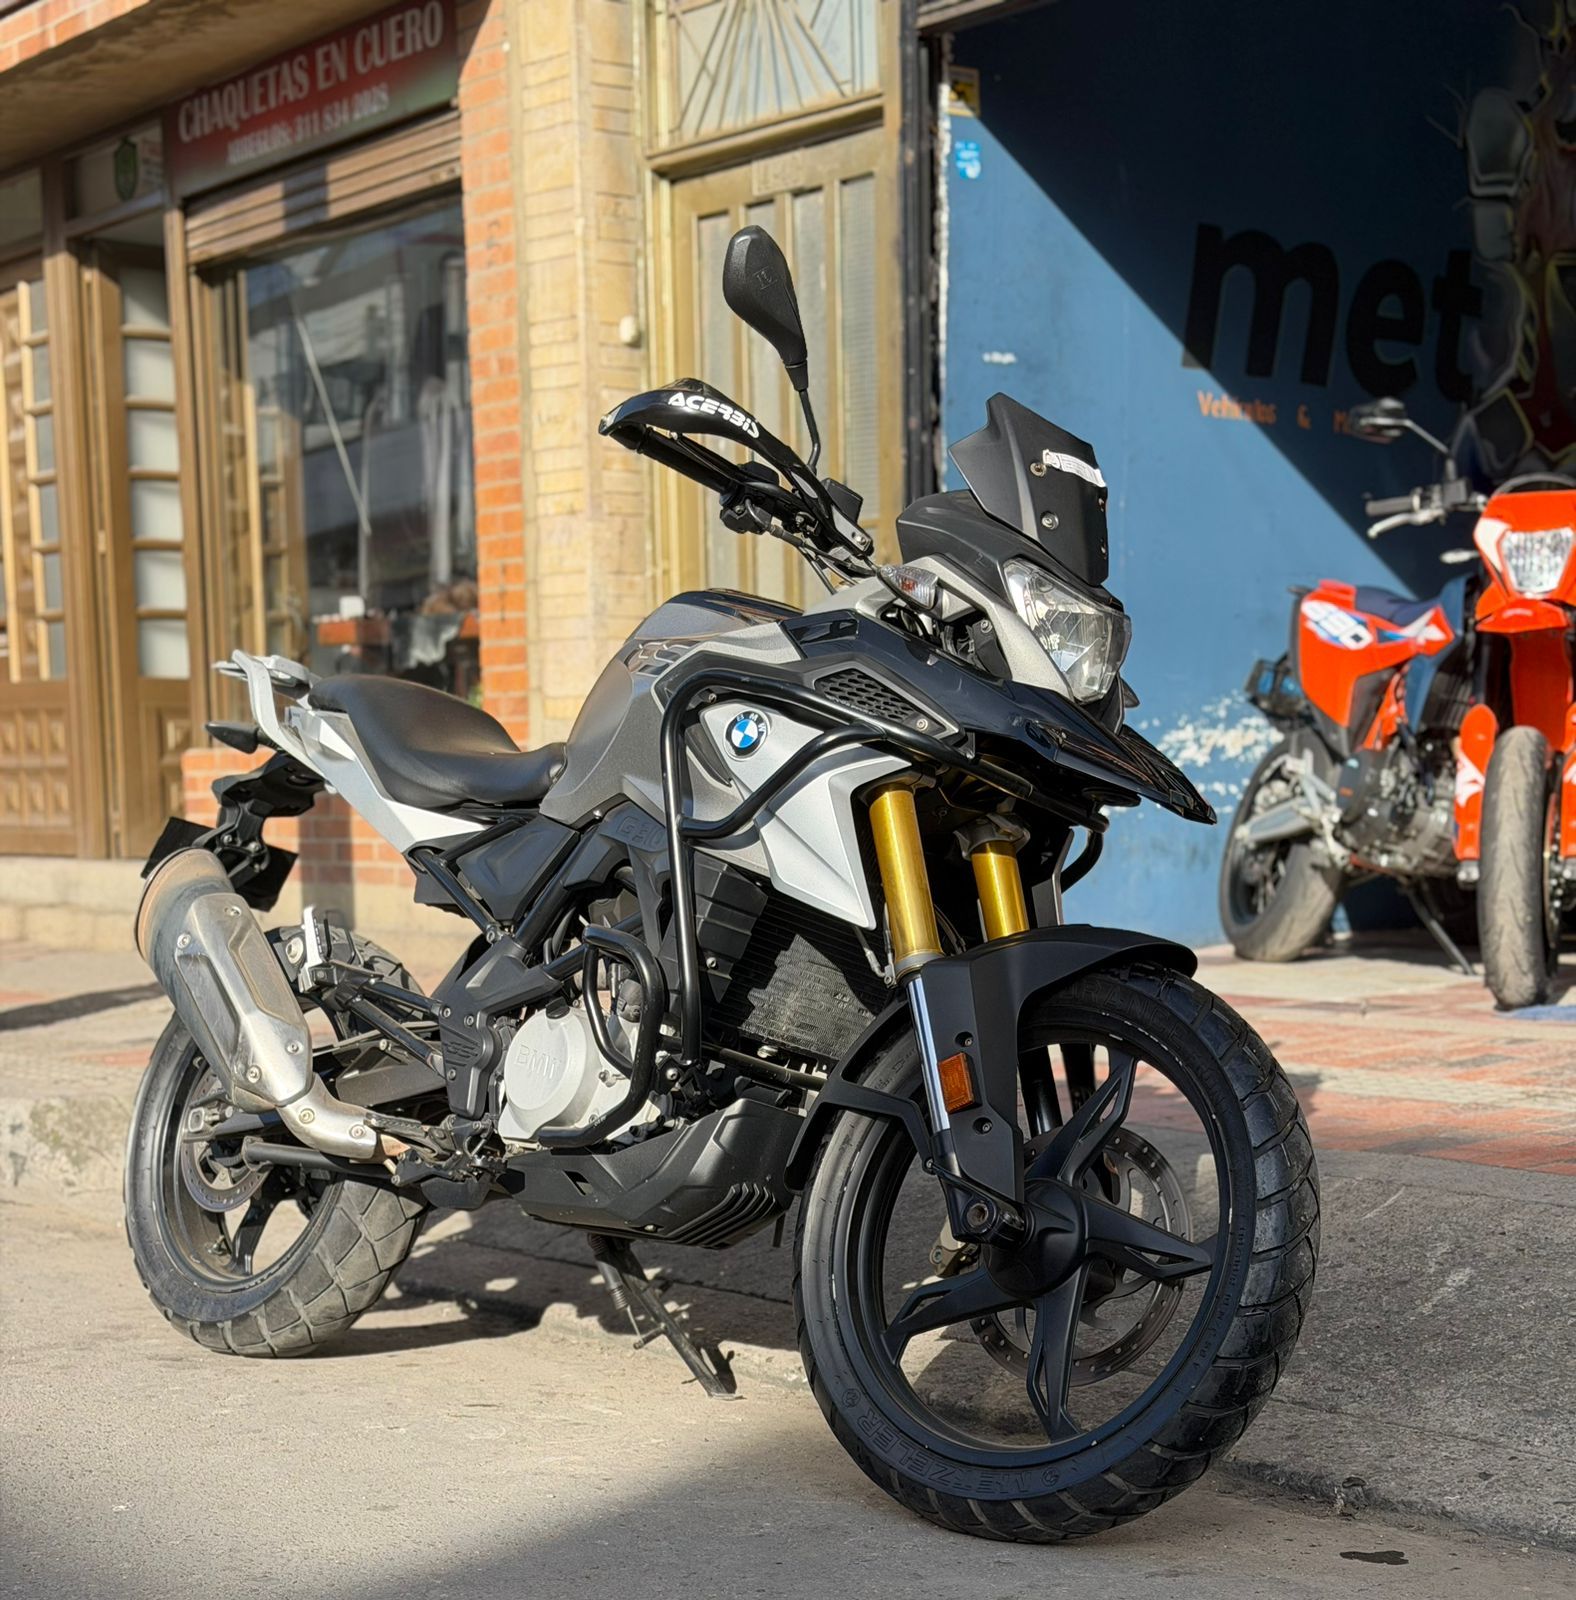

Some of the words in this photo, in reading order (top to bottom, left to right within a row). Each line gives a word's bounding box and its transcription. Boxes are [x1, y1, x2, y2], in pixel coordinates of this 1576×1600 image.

[178, 56, 308, 143] CHAQUETAS
[314, 38, 347, 90] EN
[354, 1, 443, 74] CUERO
[1182, 222, 1482, 404] met
[736, 712, 766, 732] BMW
